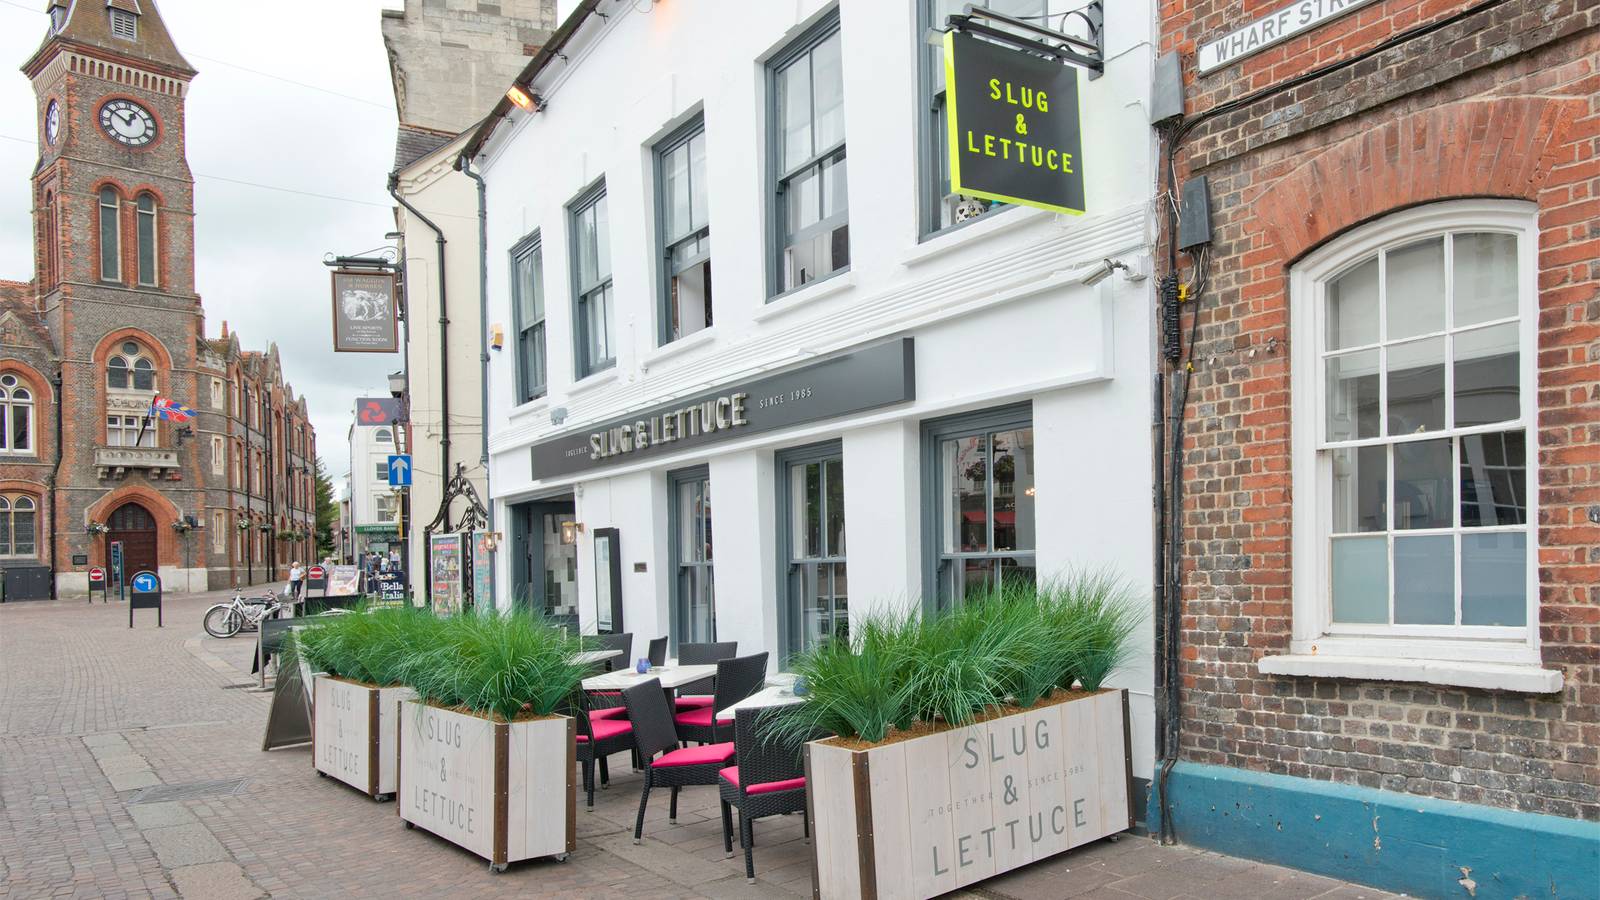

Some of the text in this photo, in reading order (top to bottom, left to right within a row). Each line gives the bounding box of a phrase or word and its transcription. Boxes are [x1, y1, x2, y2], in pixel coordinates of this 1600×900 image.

[1215, 0, 1356, 63] WHARF STR
[989, 78, 1049, 113] SLUG
[1015, 113, 1028, 135] &
[967, 130, 1073, 174] LETTUCE
[589, 424, 632, 461] SLUG
[635, 420, 649, 449] &
[651, 392, 747, 445] LETTUCE
[759, 394, 784, 409] SINCE
[791, 387, 812, 401] 1985
[380, 581, 404, 591] Bella
[331, 687, 351, 712] SLUG
[427, 715, 462, 749] SLUG
[963, 719, 1051, 769] SLUG
[324, 743, 359, 775] LETTUCE
[440, 756, 447, 783] &
[414, 784, 475, 835] LETTUCE
[928, 792, 994, 817] TOGETHER
[1003, 774, 1019, 805] &
[1028, 773, 1059, 789] SINCE
[932, 798, 1087, 877] LETTUCE
